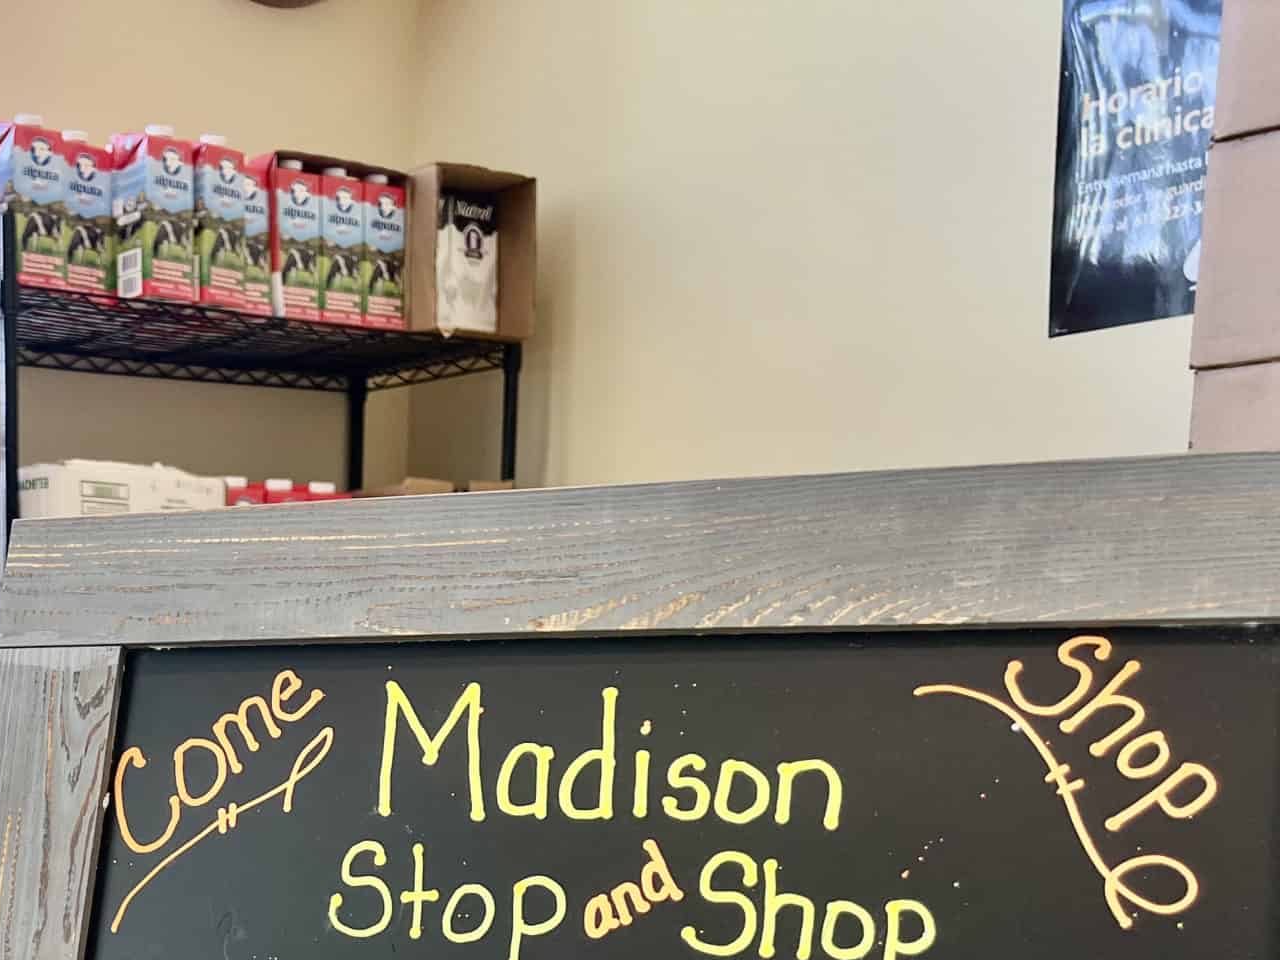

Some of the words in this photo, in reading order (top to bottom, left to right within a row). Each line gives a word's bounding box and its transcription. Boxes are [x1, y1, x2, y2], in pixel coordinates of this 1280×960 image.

[115, 670, 325, 853] Come
[378, 681, 842, 830] Madison
[1005, 635, 1217, 831] Shop
[583, 839, 683, 939] and
